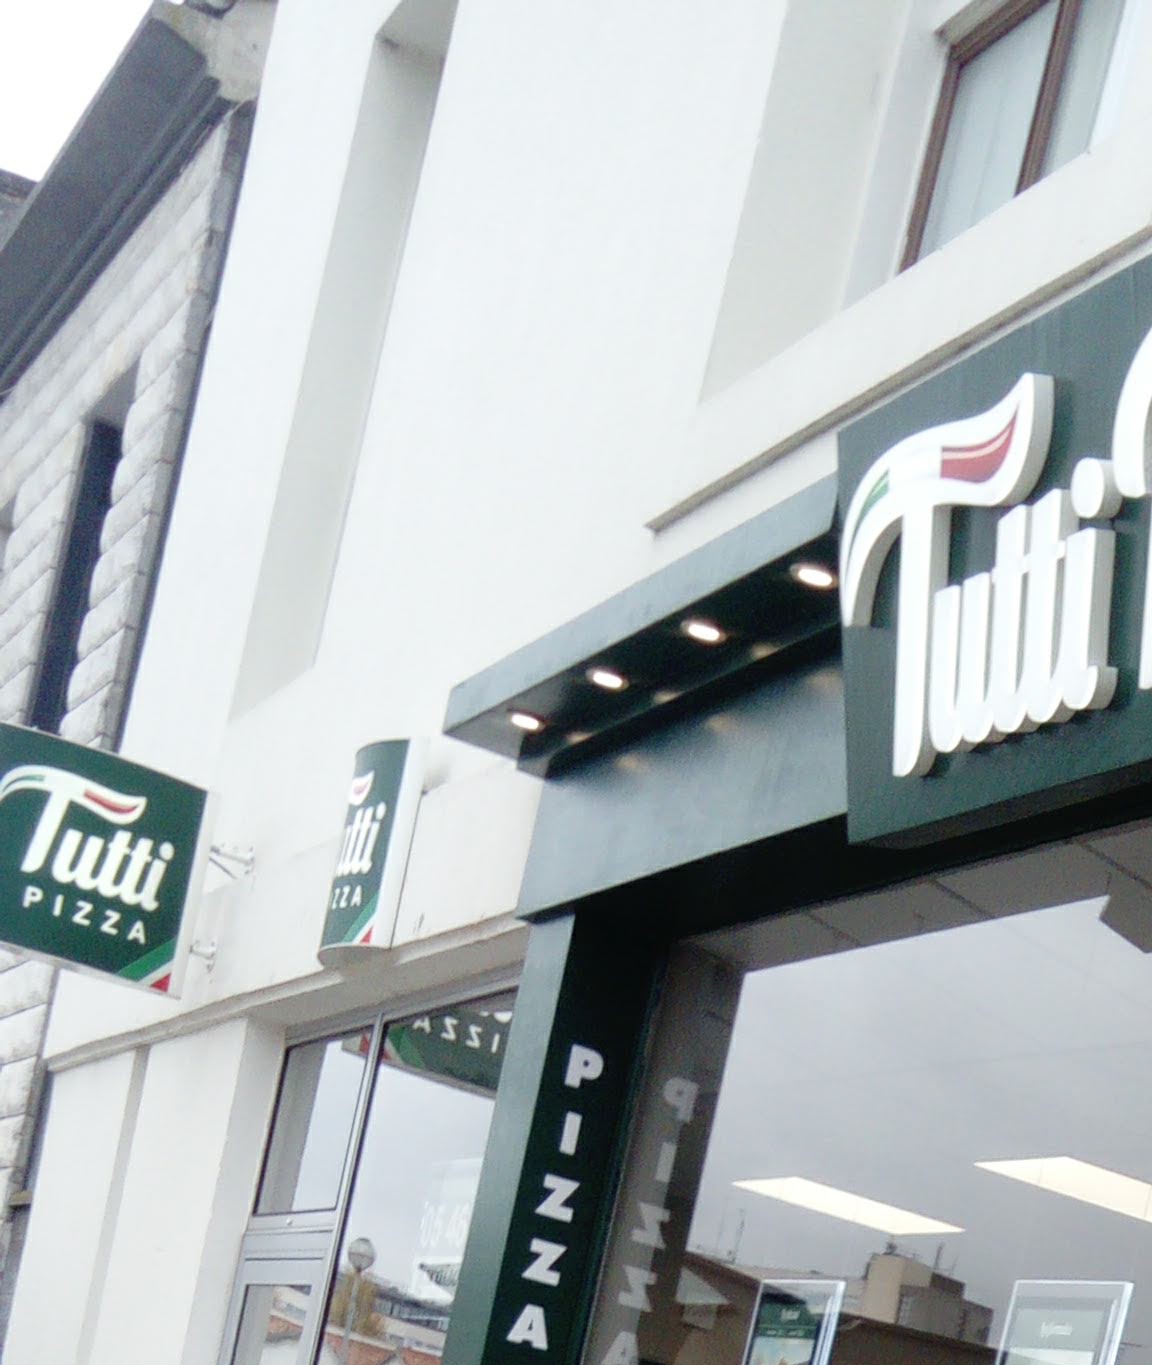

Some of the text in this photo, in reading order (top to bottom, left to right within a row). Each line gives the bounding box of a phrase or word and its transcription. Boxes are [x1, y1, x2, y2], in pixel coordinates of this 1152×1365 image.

[841, 373, 1120, 777] Tutti
[0, 765, 175, 912] Tutti
[331, 885, 362, 910] ZZA
[22, 885, 146, 944] PIZZA
[506, 1043, 604, 1350] PIZZA
